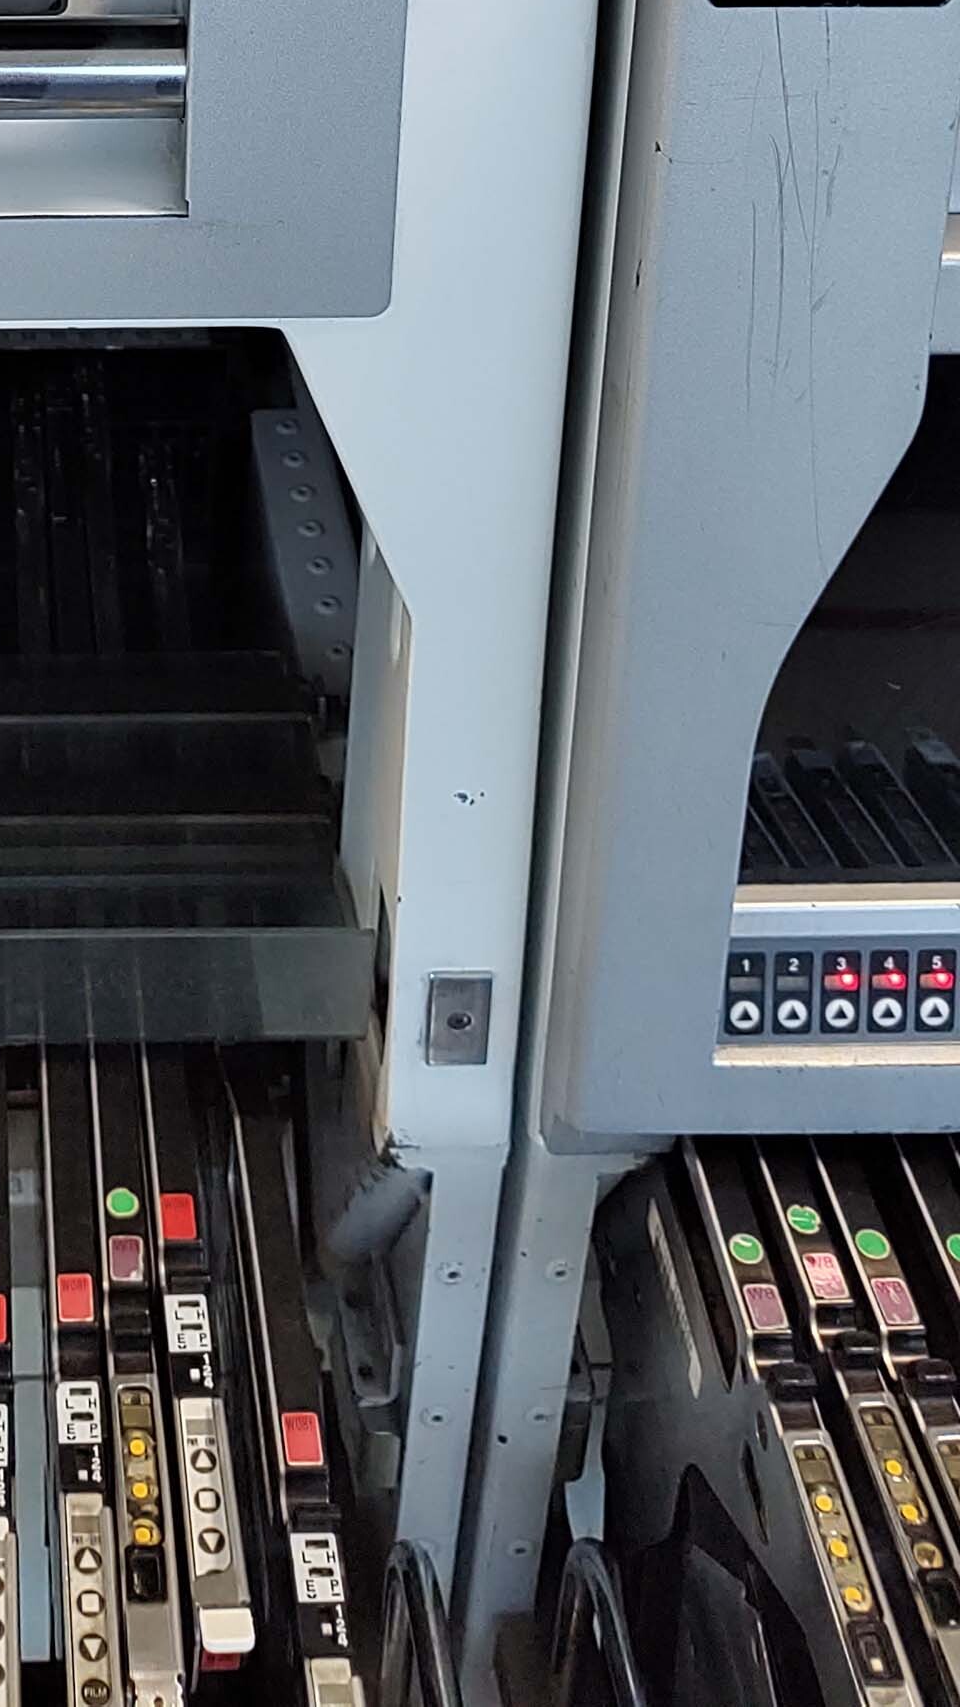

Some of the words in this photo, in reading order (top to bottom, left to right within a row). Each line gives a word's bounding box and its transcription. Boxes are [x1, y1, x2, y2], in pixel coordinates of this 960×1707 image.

[741, 958, 751, 972] 1
[788, 957, 800, 972] 2
[836, 956, 847, 970] 3
[883, 955, 895, 970] 4
[931, 955, 943, 969] 5
[175, 1310, 183, 1320] L
[197, 1310, 205, 1319] H
[65, 1398, 74, 1409] L
[88, 1398, 96, 1409] H
[302, 1551, 312, 1564] L
[327, 1551, 336, 1563] H
